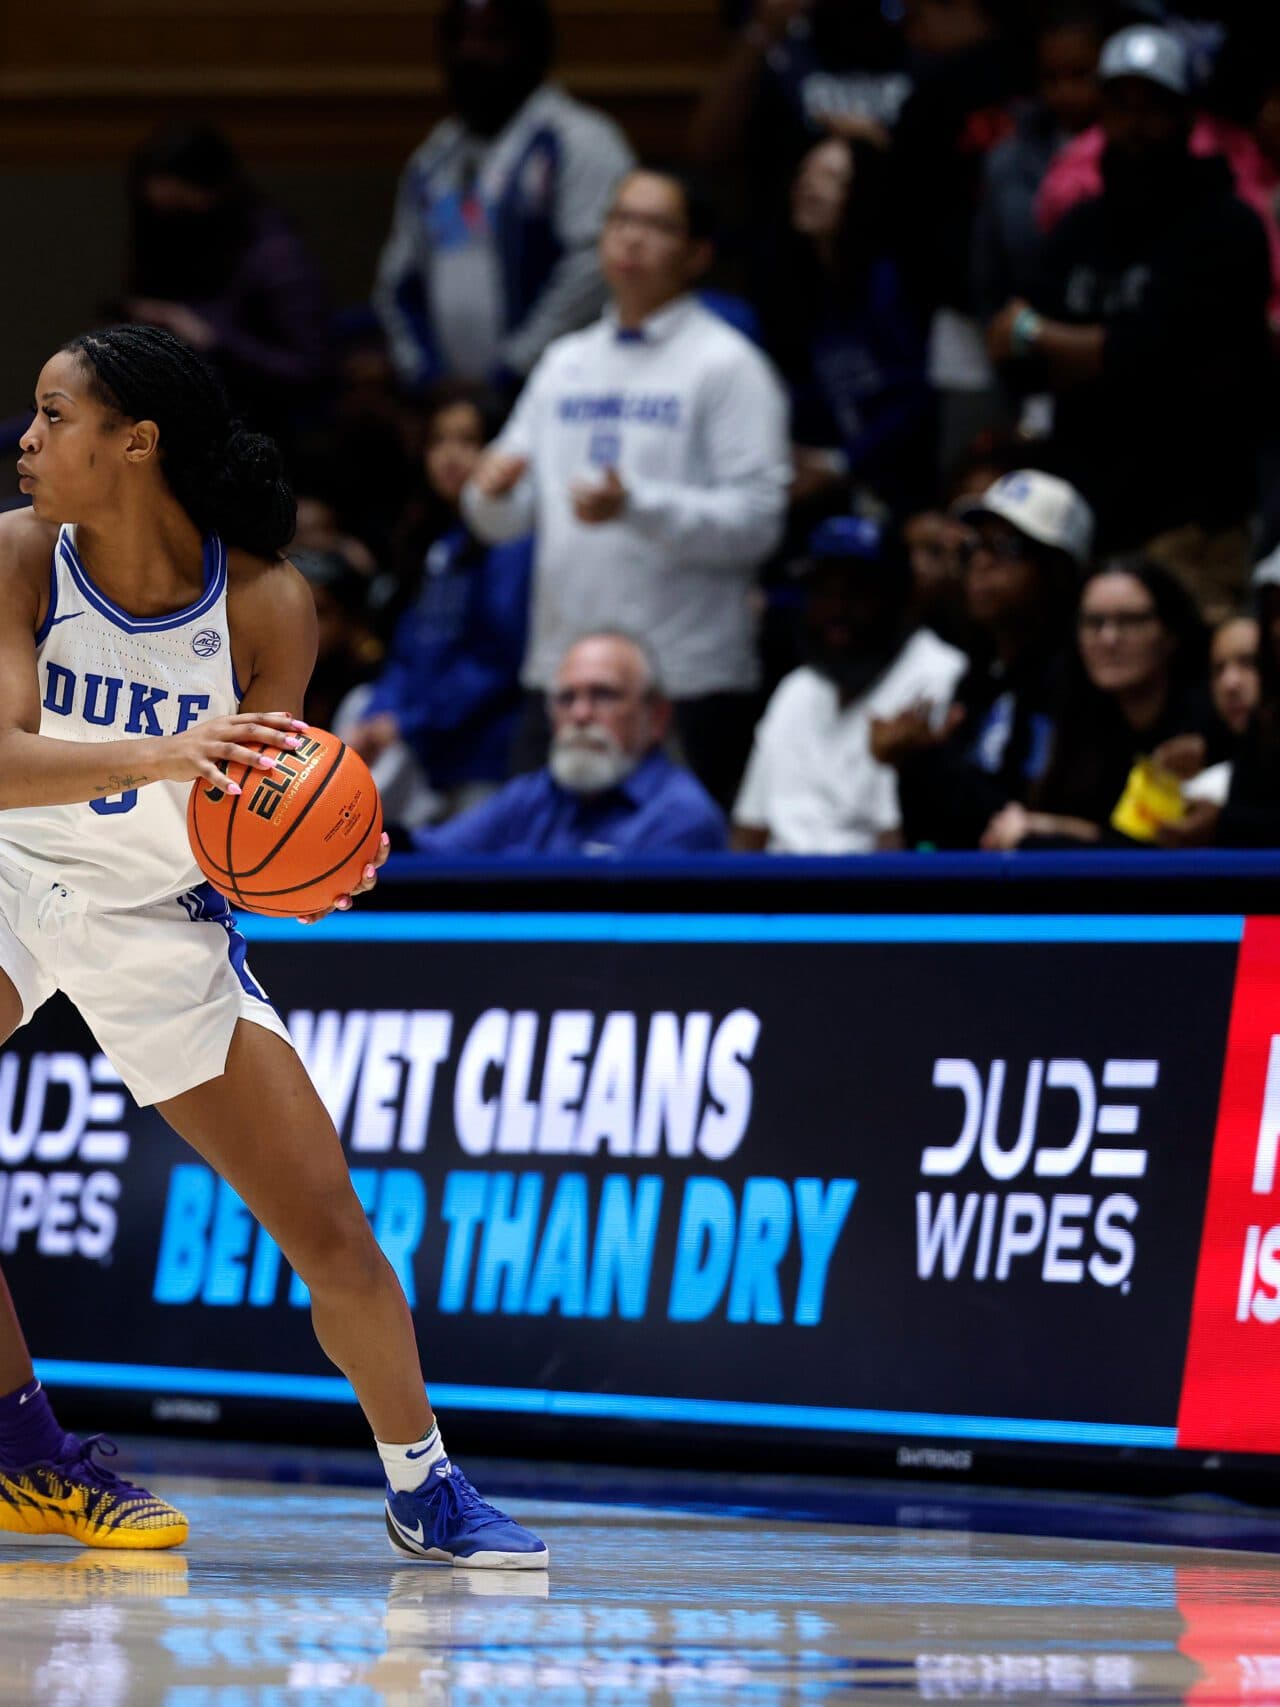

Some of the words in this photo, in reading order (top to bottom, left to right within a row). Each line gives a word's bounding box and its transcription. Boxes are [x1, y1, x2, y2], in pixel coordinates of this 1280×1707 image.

[247, 732, 321, 820] ELITE
[286, 1010, 453, 1153] WET
[453, 1007, 762, 1161] CLEANS
[919, 1057, 1160, 1180] DUDE
[439, 1170, 664, 1319] THAN
[668, 1175, 859, 1326] DRY
[916, 1191, 1140, 1289] WIPES
